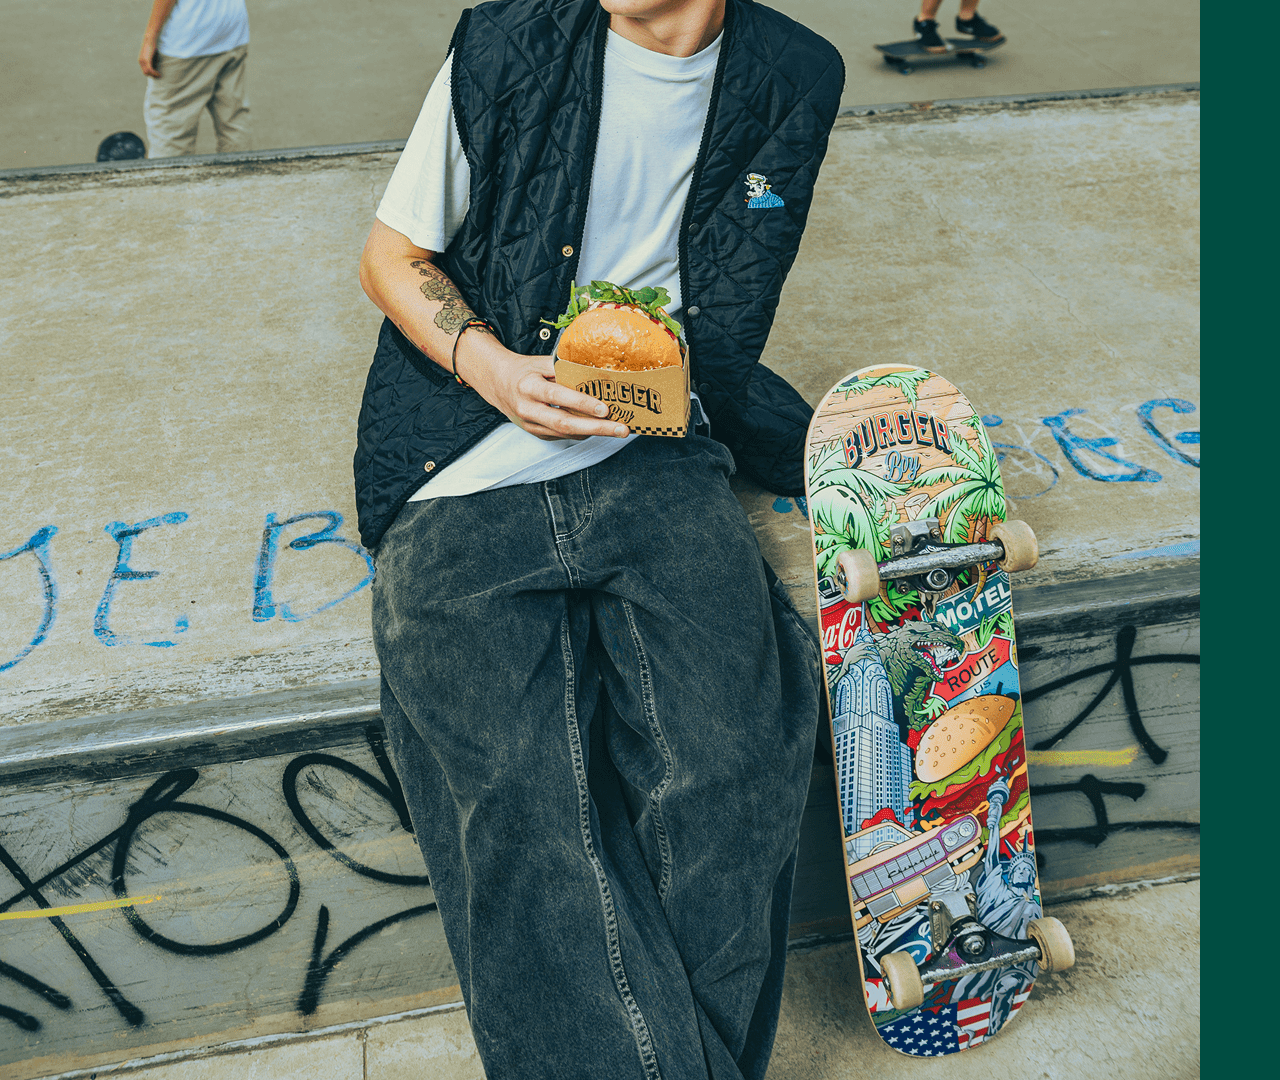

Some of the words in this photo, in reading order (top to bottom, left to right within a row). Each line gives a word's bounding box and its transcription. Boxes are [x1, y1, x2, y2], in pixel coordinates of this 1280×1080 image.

[842, 409, 953, 469] BURGER
[883, 450, 921, 482] Boy
[936, 583, 1012, 628] MOTEL
[948, 648, 1000, 692] ROUTE
[974, 679, 991, 694] US
